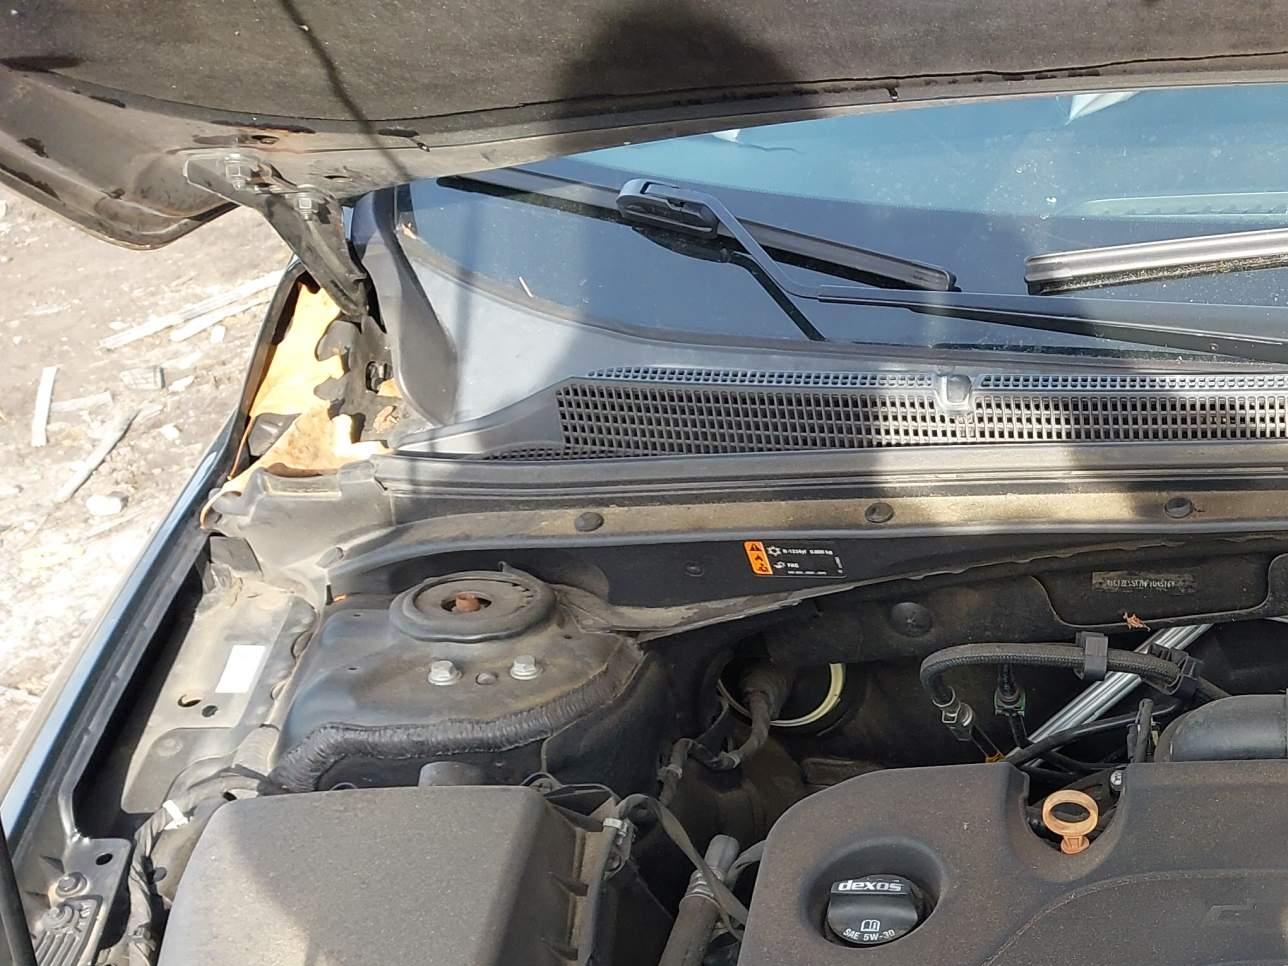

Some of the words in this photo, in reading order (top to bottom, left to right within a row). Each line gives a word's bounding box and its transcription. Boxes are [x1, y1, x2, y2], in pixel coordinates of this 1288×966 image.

[838, 880, 902, 892] dexos
[843, 928, 860, 940] SAE
[863, 929, 896, 942] 5W-30
